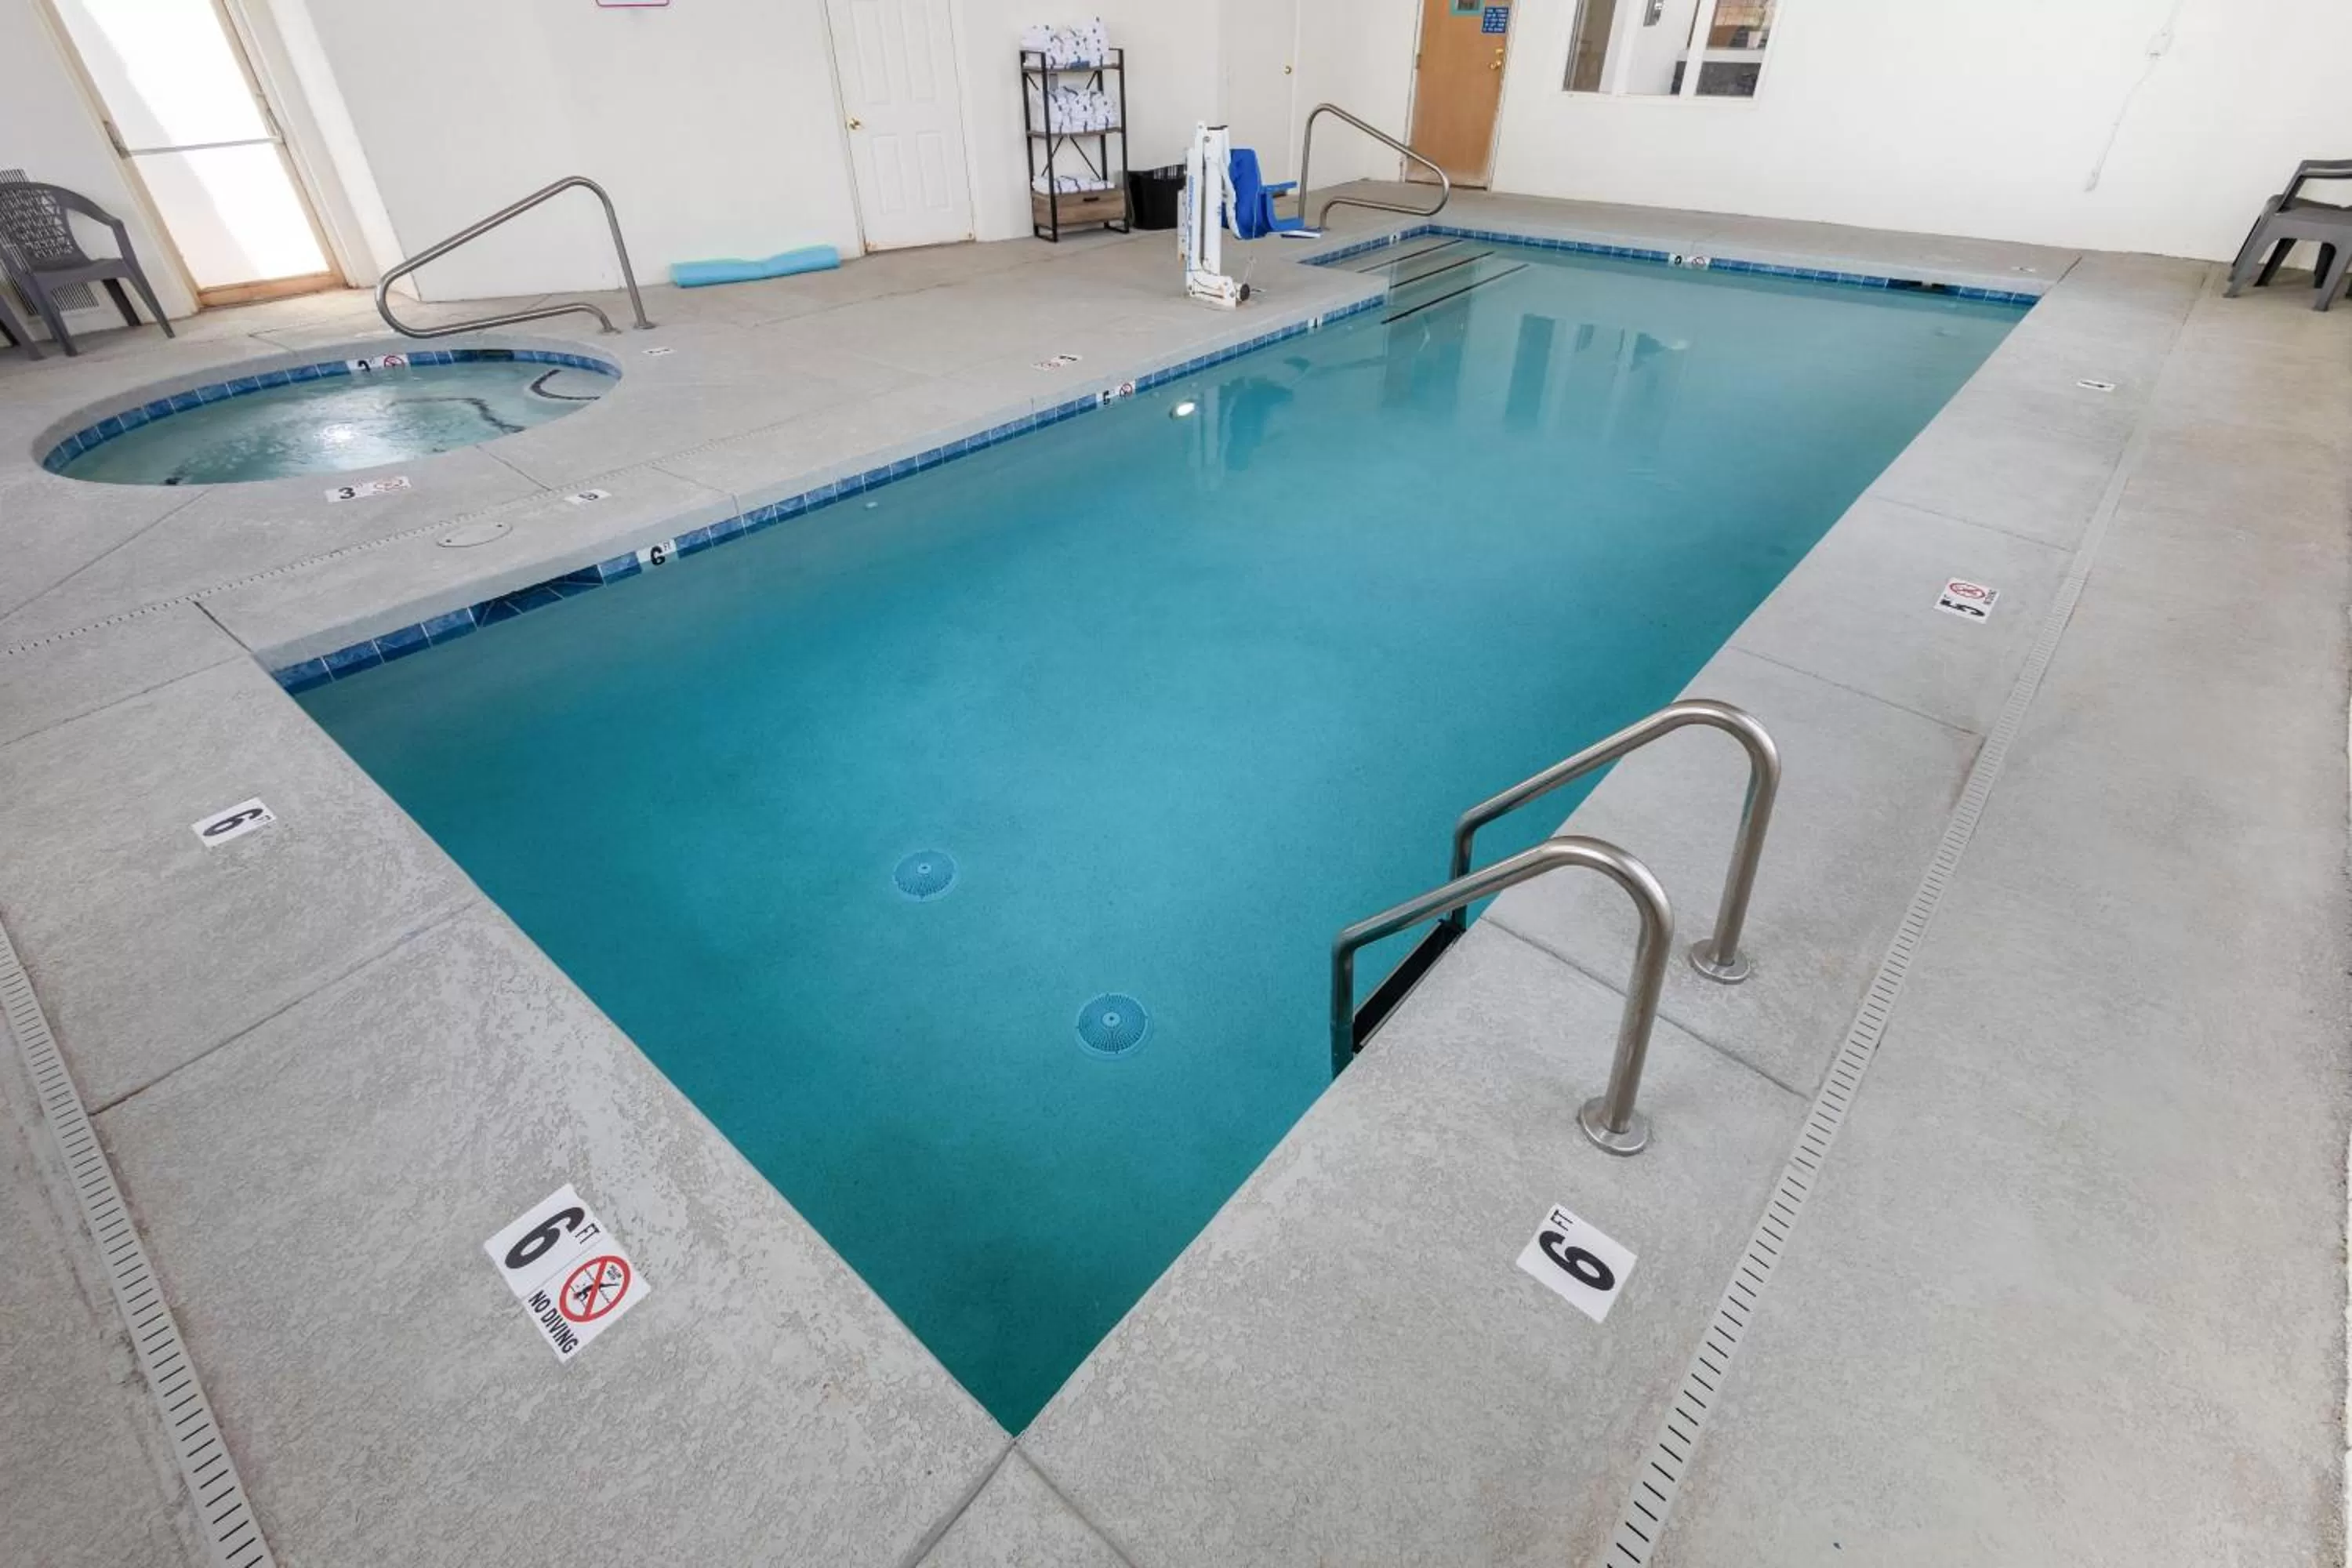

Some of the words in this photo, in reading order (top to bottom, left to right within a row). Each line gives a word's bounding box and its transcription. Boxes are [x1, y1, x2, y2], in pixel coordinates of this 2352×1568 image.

[338, 487, 355, 499] 3
[651, 546, 665, 565] 6
[1940, 600, 1985, 616] 5
[203, 808, 263, 837] 6
[1550, 1209, 1574, 1232] FT
[505, 1207, 585, 1269] 6
[575, 1223, 601, 1245] FT
[1539, 1230, 1616, 1291] 6
[528, 1290, 550, 1313] NO
[540, 1308, 580, 1354] DIVING
